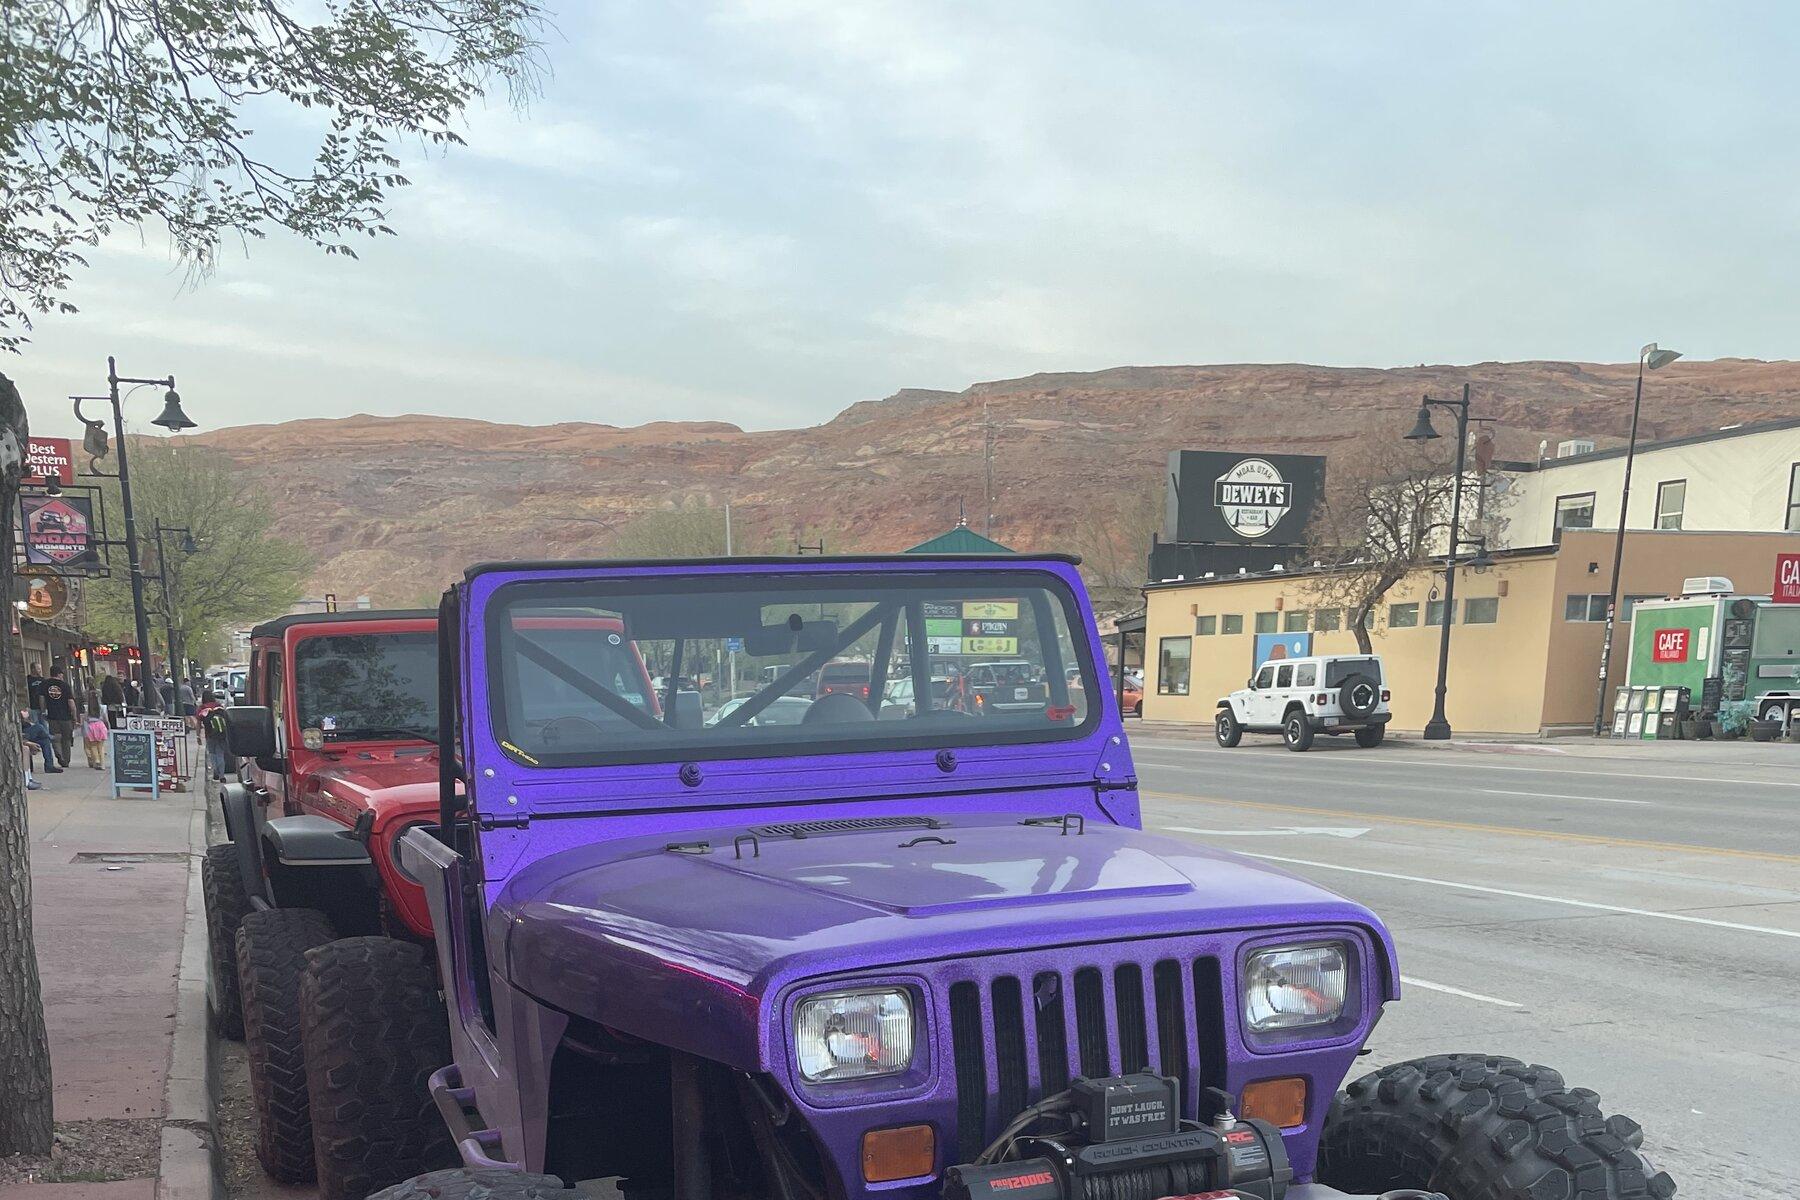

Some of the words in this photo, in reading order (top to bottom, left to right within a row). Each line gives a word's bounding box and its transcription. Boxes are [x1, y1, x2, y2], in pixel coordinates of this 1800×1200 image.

[29, 443, 56, 455] Best
[1222, 485, 1284, 504] DEWEY'S
[35, 543, 86, 551] MOMENTO
[1659, 633, 1684, 650] CAFE
[1109, 1116, 1122, 1127] IT
[1121, 1113, 1141, 1125] WAS
[1141, 1111, 1167, 1123] FREE
[1141, 1135, 1203, 1154] COUNTRY
